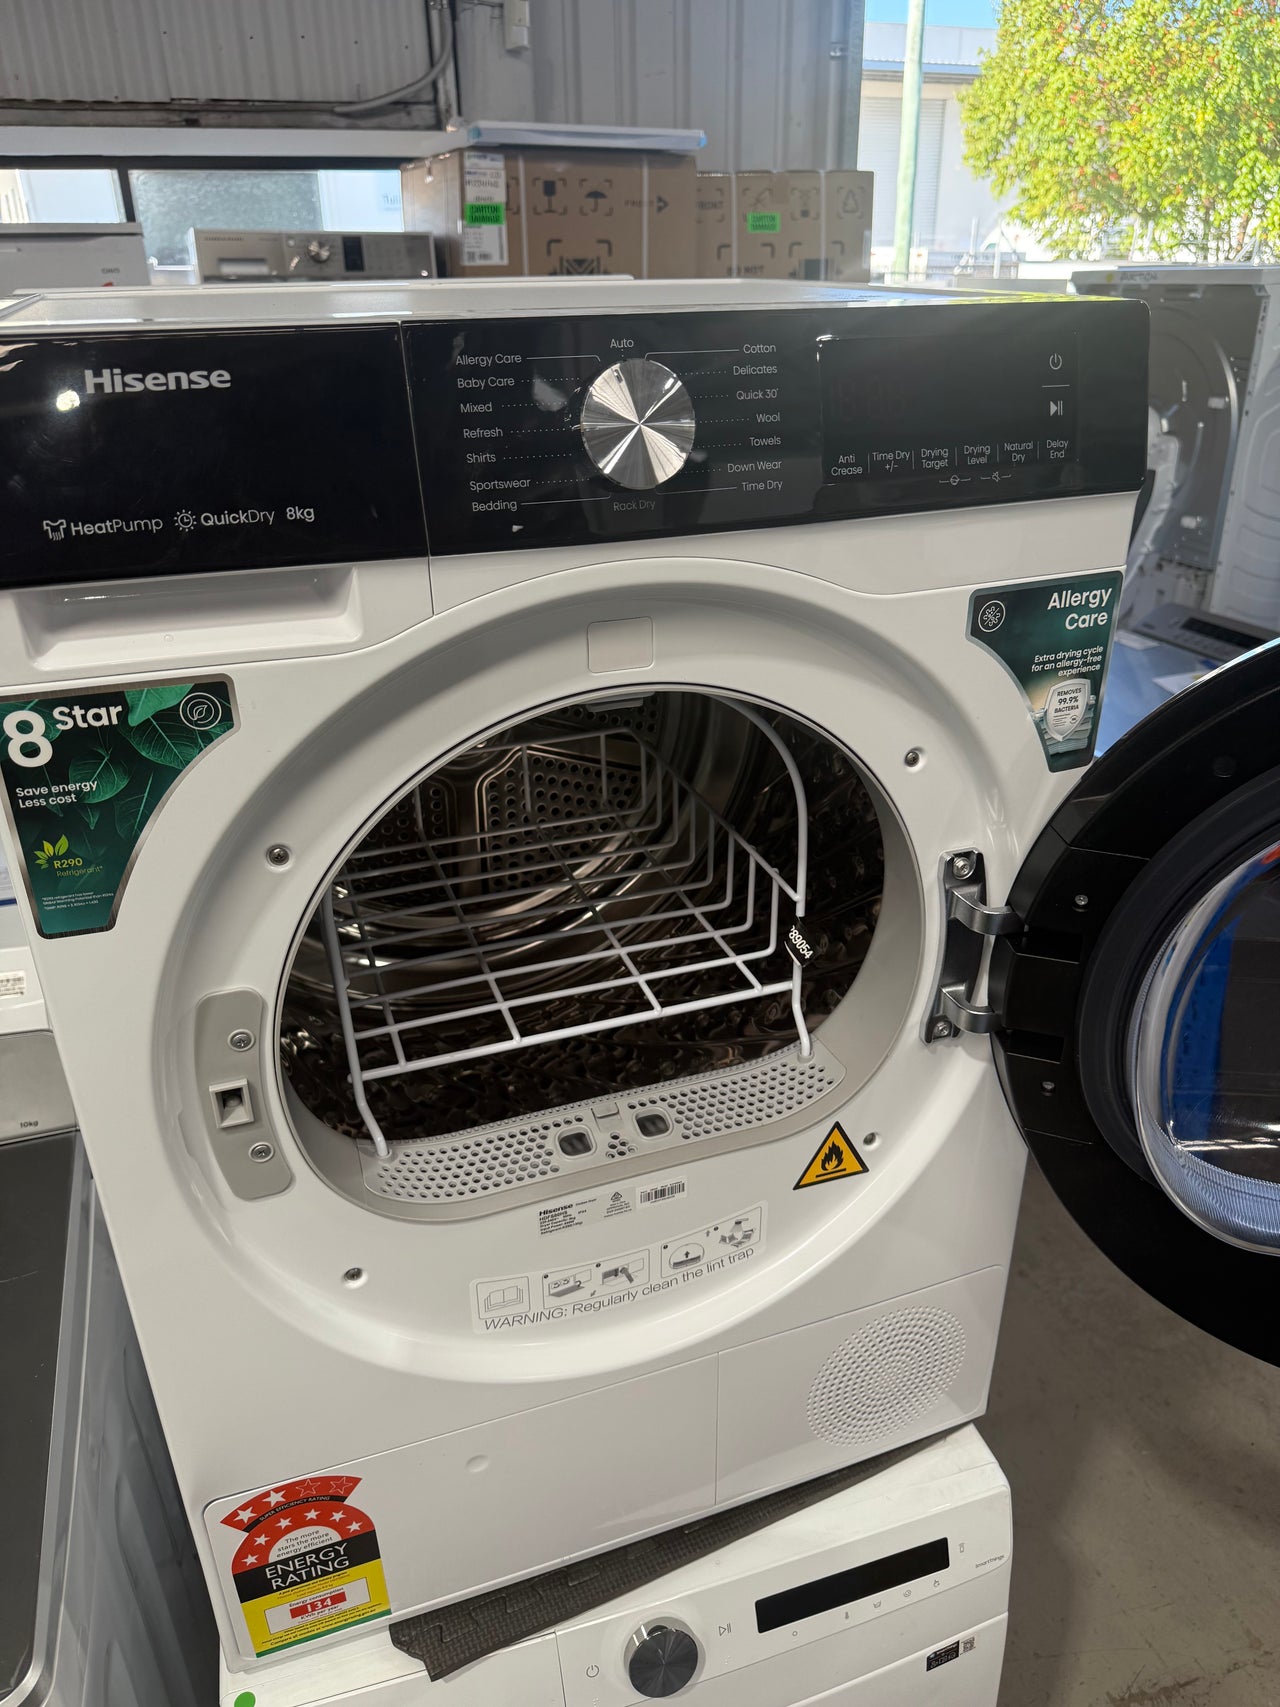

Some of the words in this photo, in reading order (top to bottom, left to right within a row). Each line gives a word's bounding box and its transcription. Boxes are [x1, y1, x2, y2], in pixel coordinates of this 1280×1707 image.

[610, 338, 634, 349] Auto
[743, 343, 776, 354] Cotton
[456, 354, 494, 366] Allergy
[495, 353, 522, 364] Care
[733, 364, 777, 376] Delicates
[84, 368, 232, 394] Hisense
[457, 377, 487, 390] Baby
[488, 376, 515, 387] Care
[736, 390, 762, 401] Quick
[460, 402, 493, 413] Mixed
[756, 412, 781, 423] Wool
[463, 427, 503, 438] Refresh
[749, 435, 781, 446] Towels
[1004, 441, 1033, 452] Natural
[1046, 439, 1069, 450] Delay
[872, 451, 893, 462] Time
[893, 450, 910, 462] Dry
[921, 447, 948, 460] Drying
[963, 444, 990, 457] Drying
[1050, 449, 1065, 459] End
[466, 452, 496, 464] Shirts
[838, 453, 856, 464] Anti
[967, 454, 988, 465] Level
[1012, 452, 1026, 463] Dry
[727, 462, 755, 473] Down
[758, 460, 782, 471] Wear
[885, 461, 898, 472] +/-
[921, 458, 948, 470] Target
[831, 465, 863, 477] Crease
[470, 477, 531, 492] Sportswear
[742, 481, 764, 492] Time
[765, 479, 783, 492] Dry
[472, 500, 517, 512] Bedding
[613, 500, 637, 512] Rack
[638, 499, 656, 511] Dry
[200, 508, 275, 527] QuickDry
[286, 506, 315, 522] 8kg
[70, 515, 163, 536] HeatPump
[1047, 587, 1112, 611] Allergy
[1065, 611, 1108, 630] Care
[1035, 653, 1055, 663] Extra
[1056, 649, 1082, 662] drying
[1083, 645, 1104, 656] cycle
[1031, 663, 1043, 672] for
[1045, 663, 1055, 671] an
[1056, 654, 1102, 669] allergy-free
[1058, 664, 1101, 678] experience
[1057, 687, 1082, 697] REMOVES
[1058, 696, 1079, 705] 99.9%
[1054, 704, 1079, 714] BACTERIA
[52, 702, 123, 730] Star
[3, 710, 53, 768] 8
[16, 786, 49, 797] Save
[51, 780, 98, 794] energy
[19, 798, 46, 809] Less
[49, 793, 77, 805] cost
[53, 857, 83, 869] R290
[20, 1120, 39, 1129] 10kg
[539, 1204, 573, 1216] Hisense
[485, 1307, 568, 1330] WARNING:
[572, 1289, 638, 1315] Regularly
[642, 1276, 678, 1296] clean
[682, 1267, 703, 1282] the
[707, 1259, 725, 1273] lint
[728, 1247, 754, 1264] trap
[259, 1509, 277, 1521] SUPER
[275, 1498, 307, 1511] EFFICIENCY
[300, 1530, 320, 1538] more
[276, 1546, 302, 1558] energy
[303, 1536, 333, 1549] efficient
[277, 1544, 296, 1552] stars
[296, 1538, 309, 1546] the
[310, 1532, 330, 1541] more
[265, 1542, 348, 1579] ENERGY
[271, 1556, 350, 1590] RATING
[289, 1598, 308, 1608] Energy
[306, 1597, 332, 1612] 134
